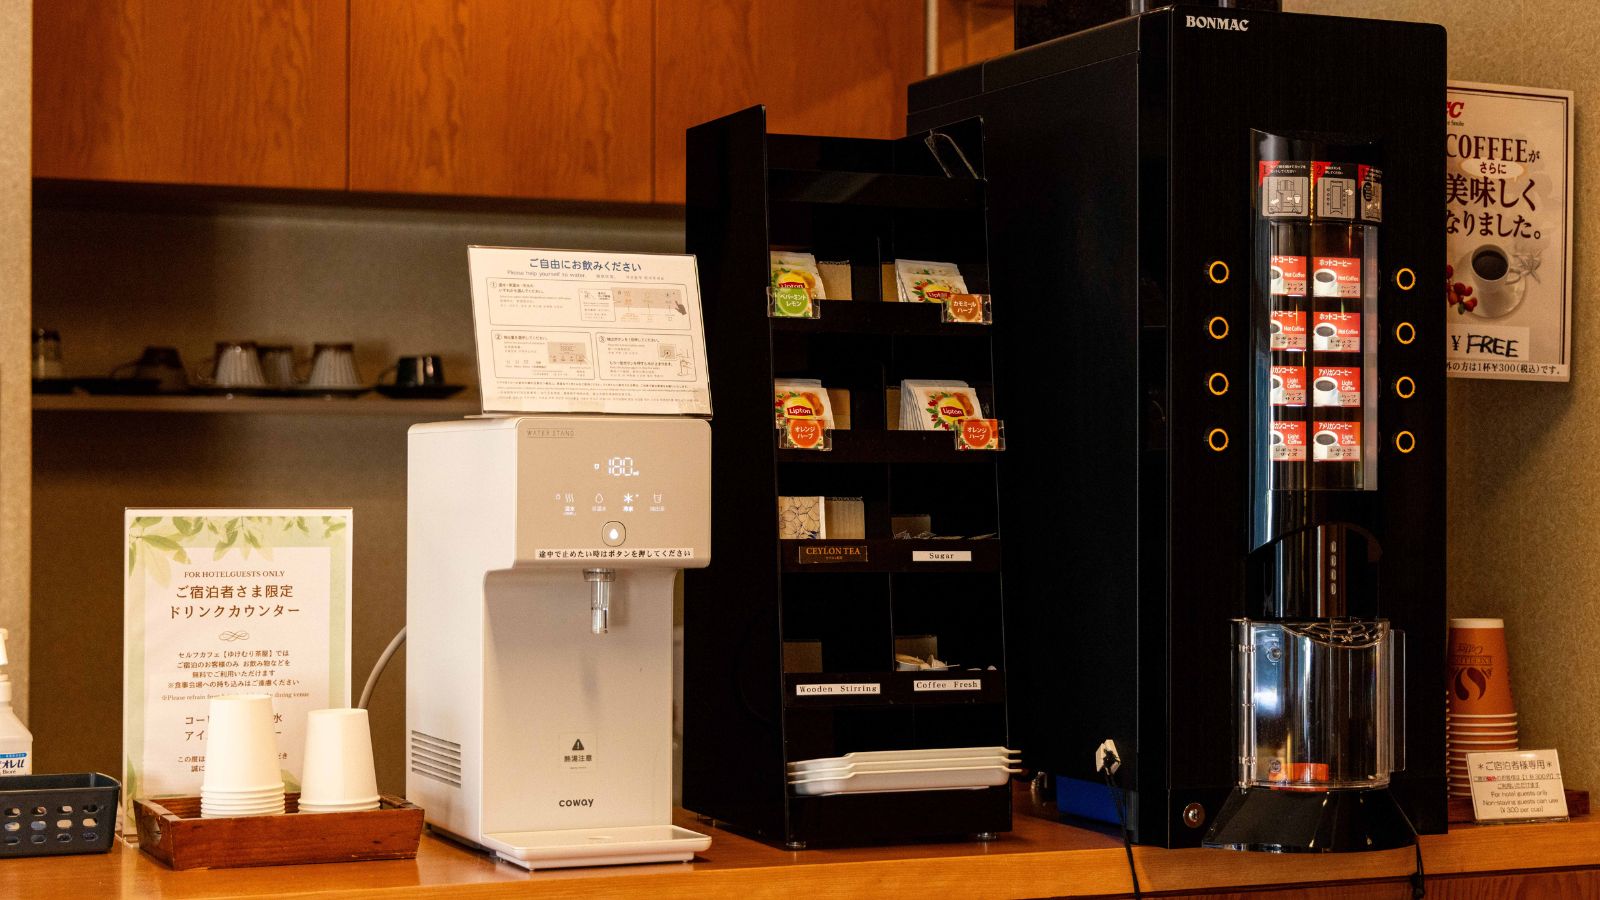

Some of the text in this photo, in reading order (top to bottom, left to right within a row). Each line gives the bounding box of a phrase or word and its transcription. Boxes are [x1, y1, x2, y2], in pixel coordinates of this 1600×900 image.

[1186, 15, 1249, 32] BONMAC
[1480, 162, 1506, 174] さらに
[1447, 174, 1536, 210] 美味しく
[1447, 210, 1540, 240] なりました。
[529, 258, 642, 272] ご自由にお飲みください
[1452, 333, 1518, 357] ¥ FREE
[943, 407, 962, 416] Lipton
[608, 457, 633, 476] 180
[176, 584, 293, 599] ご宿泊者さま限定
[170, 604, 300, 619] ドリンクカウンター
[274, 713, 282, 723] 水
[0, 759, 24, 768] オレu
[559, 799, 594, 807] coway
